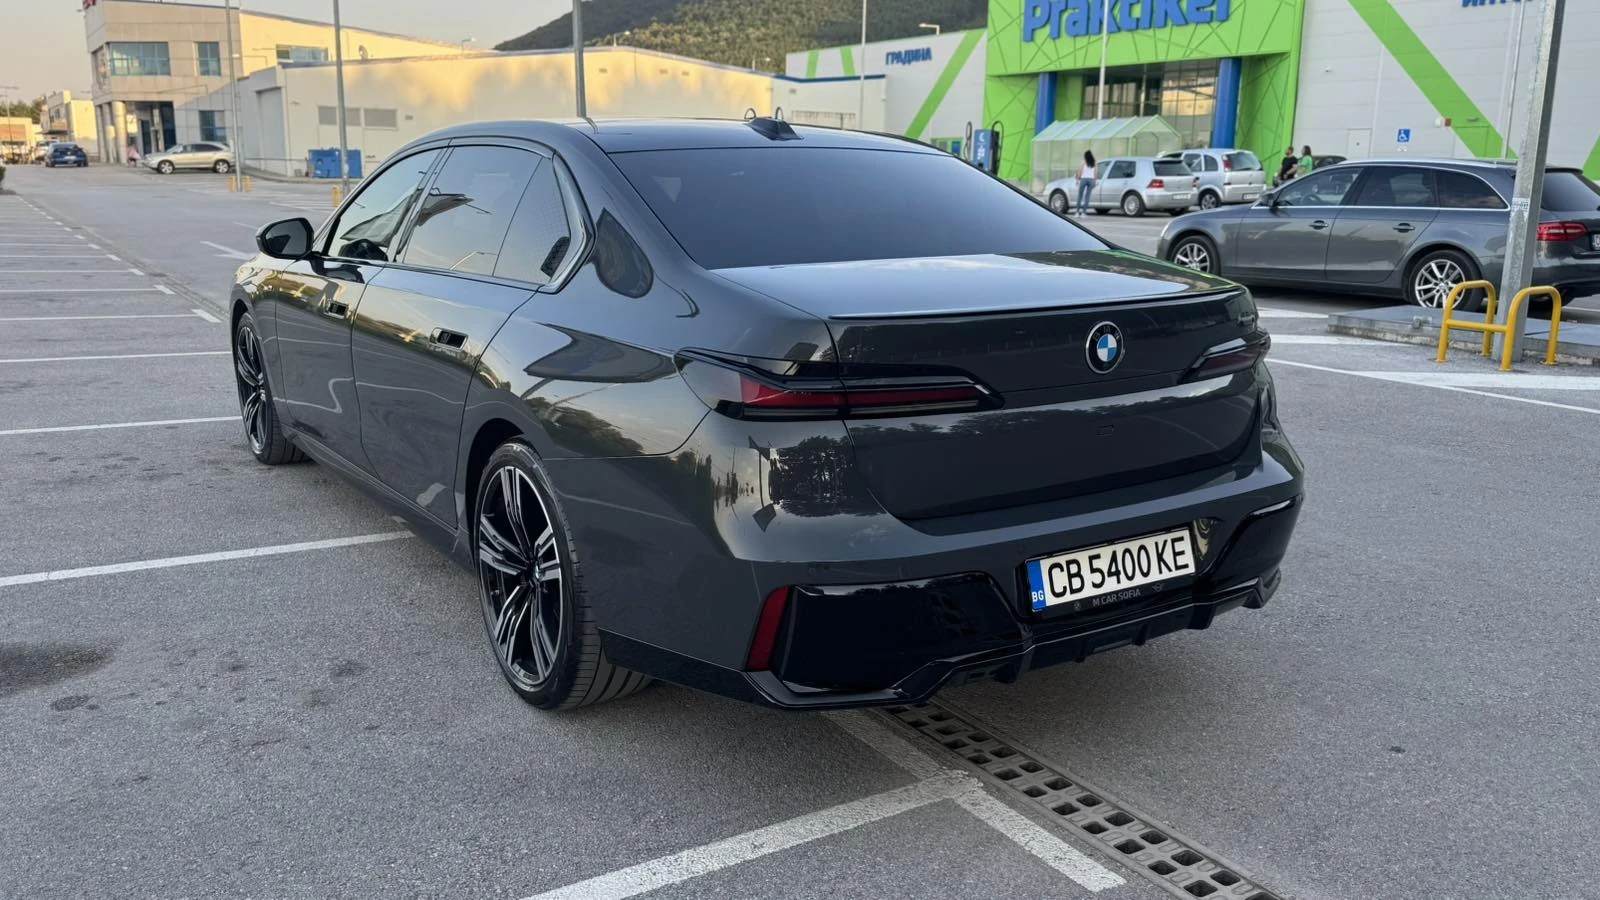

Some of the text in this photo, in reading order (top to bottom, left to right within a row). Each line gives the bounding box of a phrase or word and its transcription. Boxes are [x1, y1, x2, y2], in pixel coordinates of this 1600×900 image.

[1023, 0, 1230, 42] Praktiker
[886, 47, 932, 65] ГРАДИНА
[1032, 591, 1044, 602] BG
[1102, 594, 1118, 605] CAR
[1118, 588, 1141, 600] SOFIA
